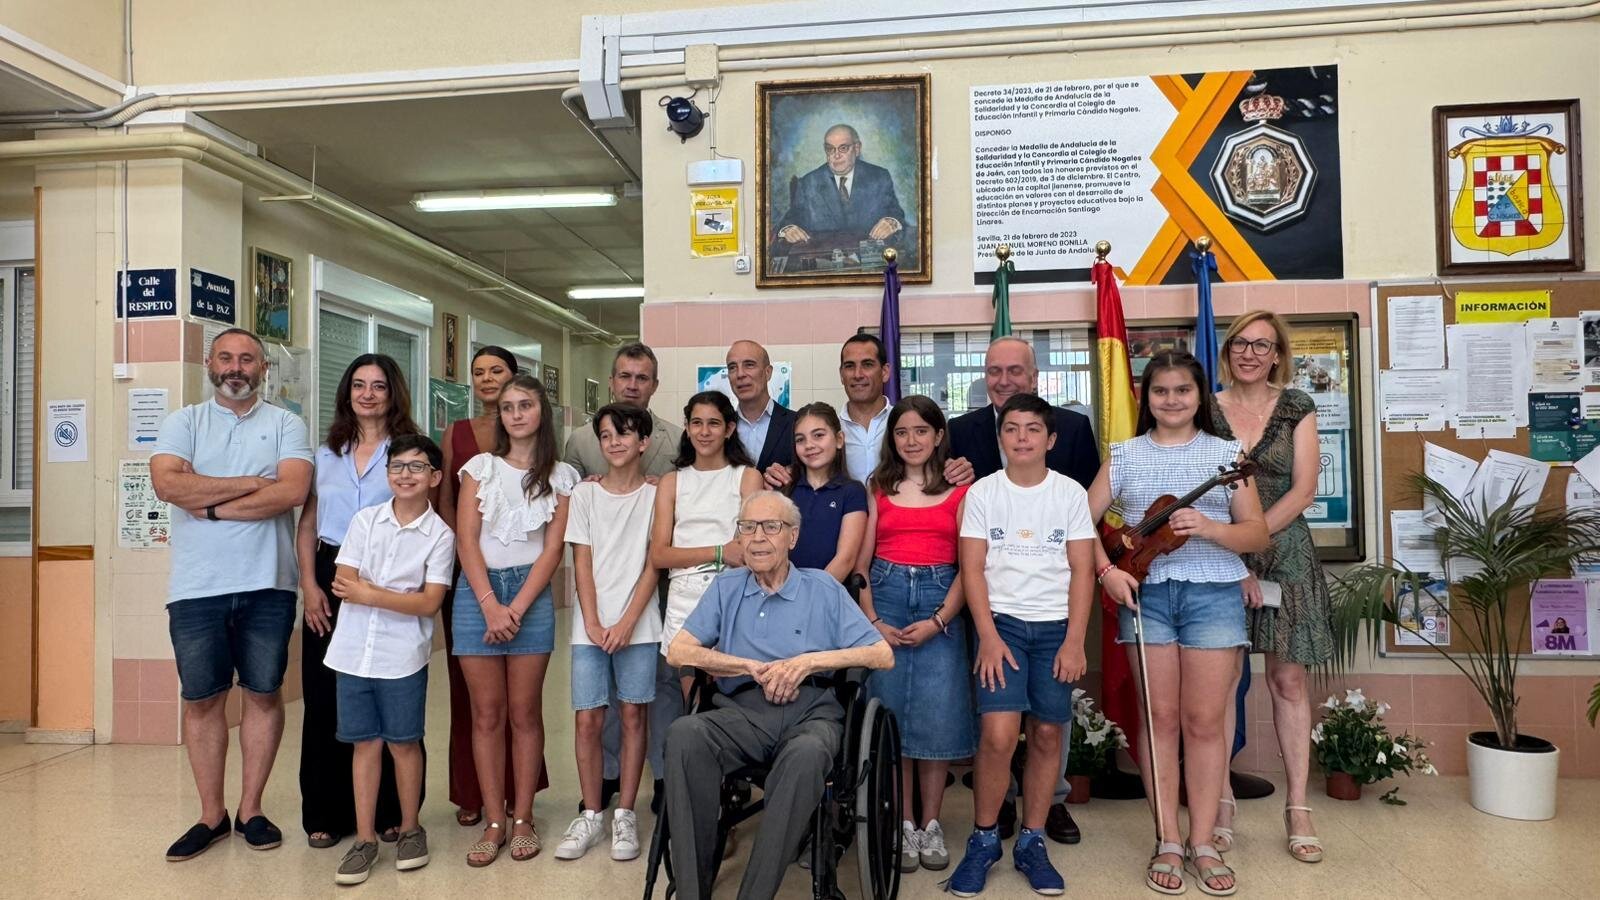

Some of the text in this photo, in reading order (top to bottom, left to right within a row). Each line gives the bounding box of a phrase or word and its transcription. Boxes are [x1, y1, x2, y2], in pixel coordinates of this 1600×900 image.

[1064, 84, 1092, 94] febrero,
[974, 97, 1005, 105] concede
[1055, 92, 1092, 101] Andalucía
[974, 104, 1015, 113] Solidaridad
[1030, 101, 1068, 110] Concordia
[1078, 99, 1105, 109] Colegio
[975, 112, 1012, 121] Educación
[1045, 109, 1075, 117] Primaria
[1077, 108, 1108, 116] Cándido
[975, 145, 1010, 153] Conceder
[1060, 140, 1097, 149] Andalucía
[976, 152, 1016, 161] Solidaridad
[1032, 150, 1069, 158] Concordia
[1079, 148, 1107, 157] Colegio
[976, 161, 1013, 169] Educación
[1112, 155, 1141, 164] Nogales
[986, 170, 1005, 178] Jaén,
[1086, 164, 1119, 174] previstos
[1114, 172, 1140, 181] Centro,
[1025, 184, 1050, 193] capital
[1085, 182, 1122, 190] promueve
[976, 193, 1014, 202] educación
[1076, 189, 1112, 197] desarrollo
[1008, 201, 1032, 210] planes
[1040, 199, 1076, 208] proyectos
[1077, 197, 1117, 205] educativos
[1119, 196, 1135, 205] bajo
[1022, 207, 1066, 215] Encarnación
[1068, 206, 1100, 215] Santiago
[977, 234, 1001, 243] Sevilla,
[138, 276, 160, 286] Calle
[142, 288, 155, 297] del
[206, 282, 230, 295] Avenida
[129, 300, 172, 311] RESPETO
[196, 300, 230, 315] de la PAZ
[1460, 301, 1546, 312] INFORMACIÓN
[1545, 635, 1576, 650] 8M
